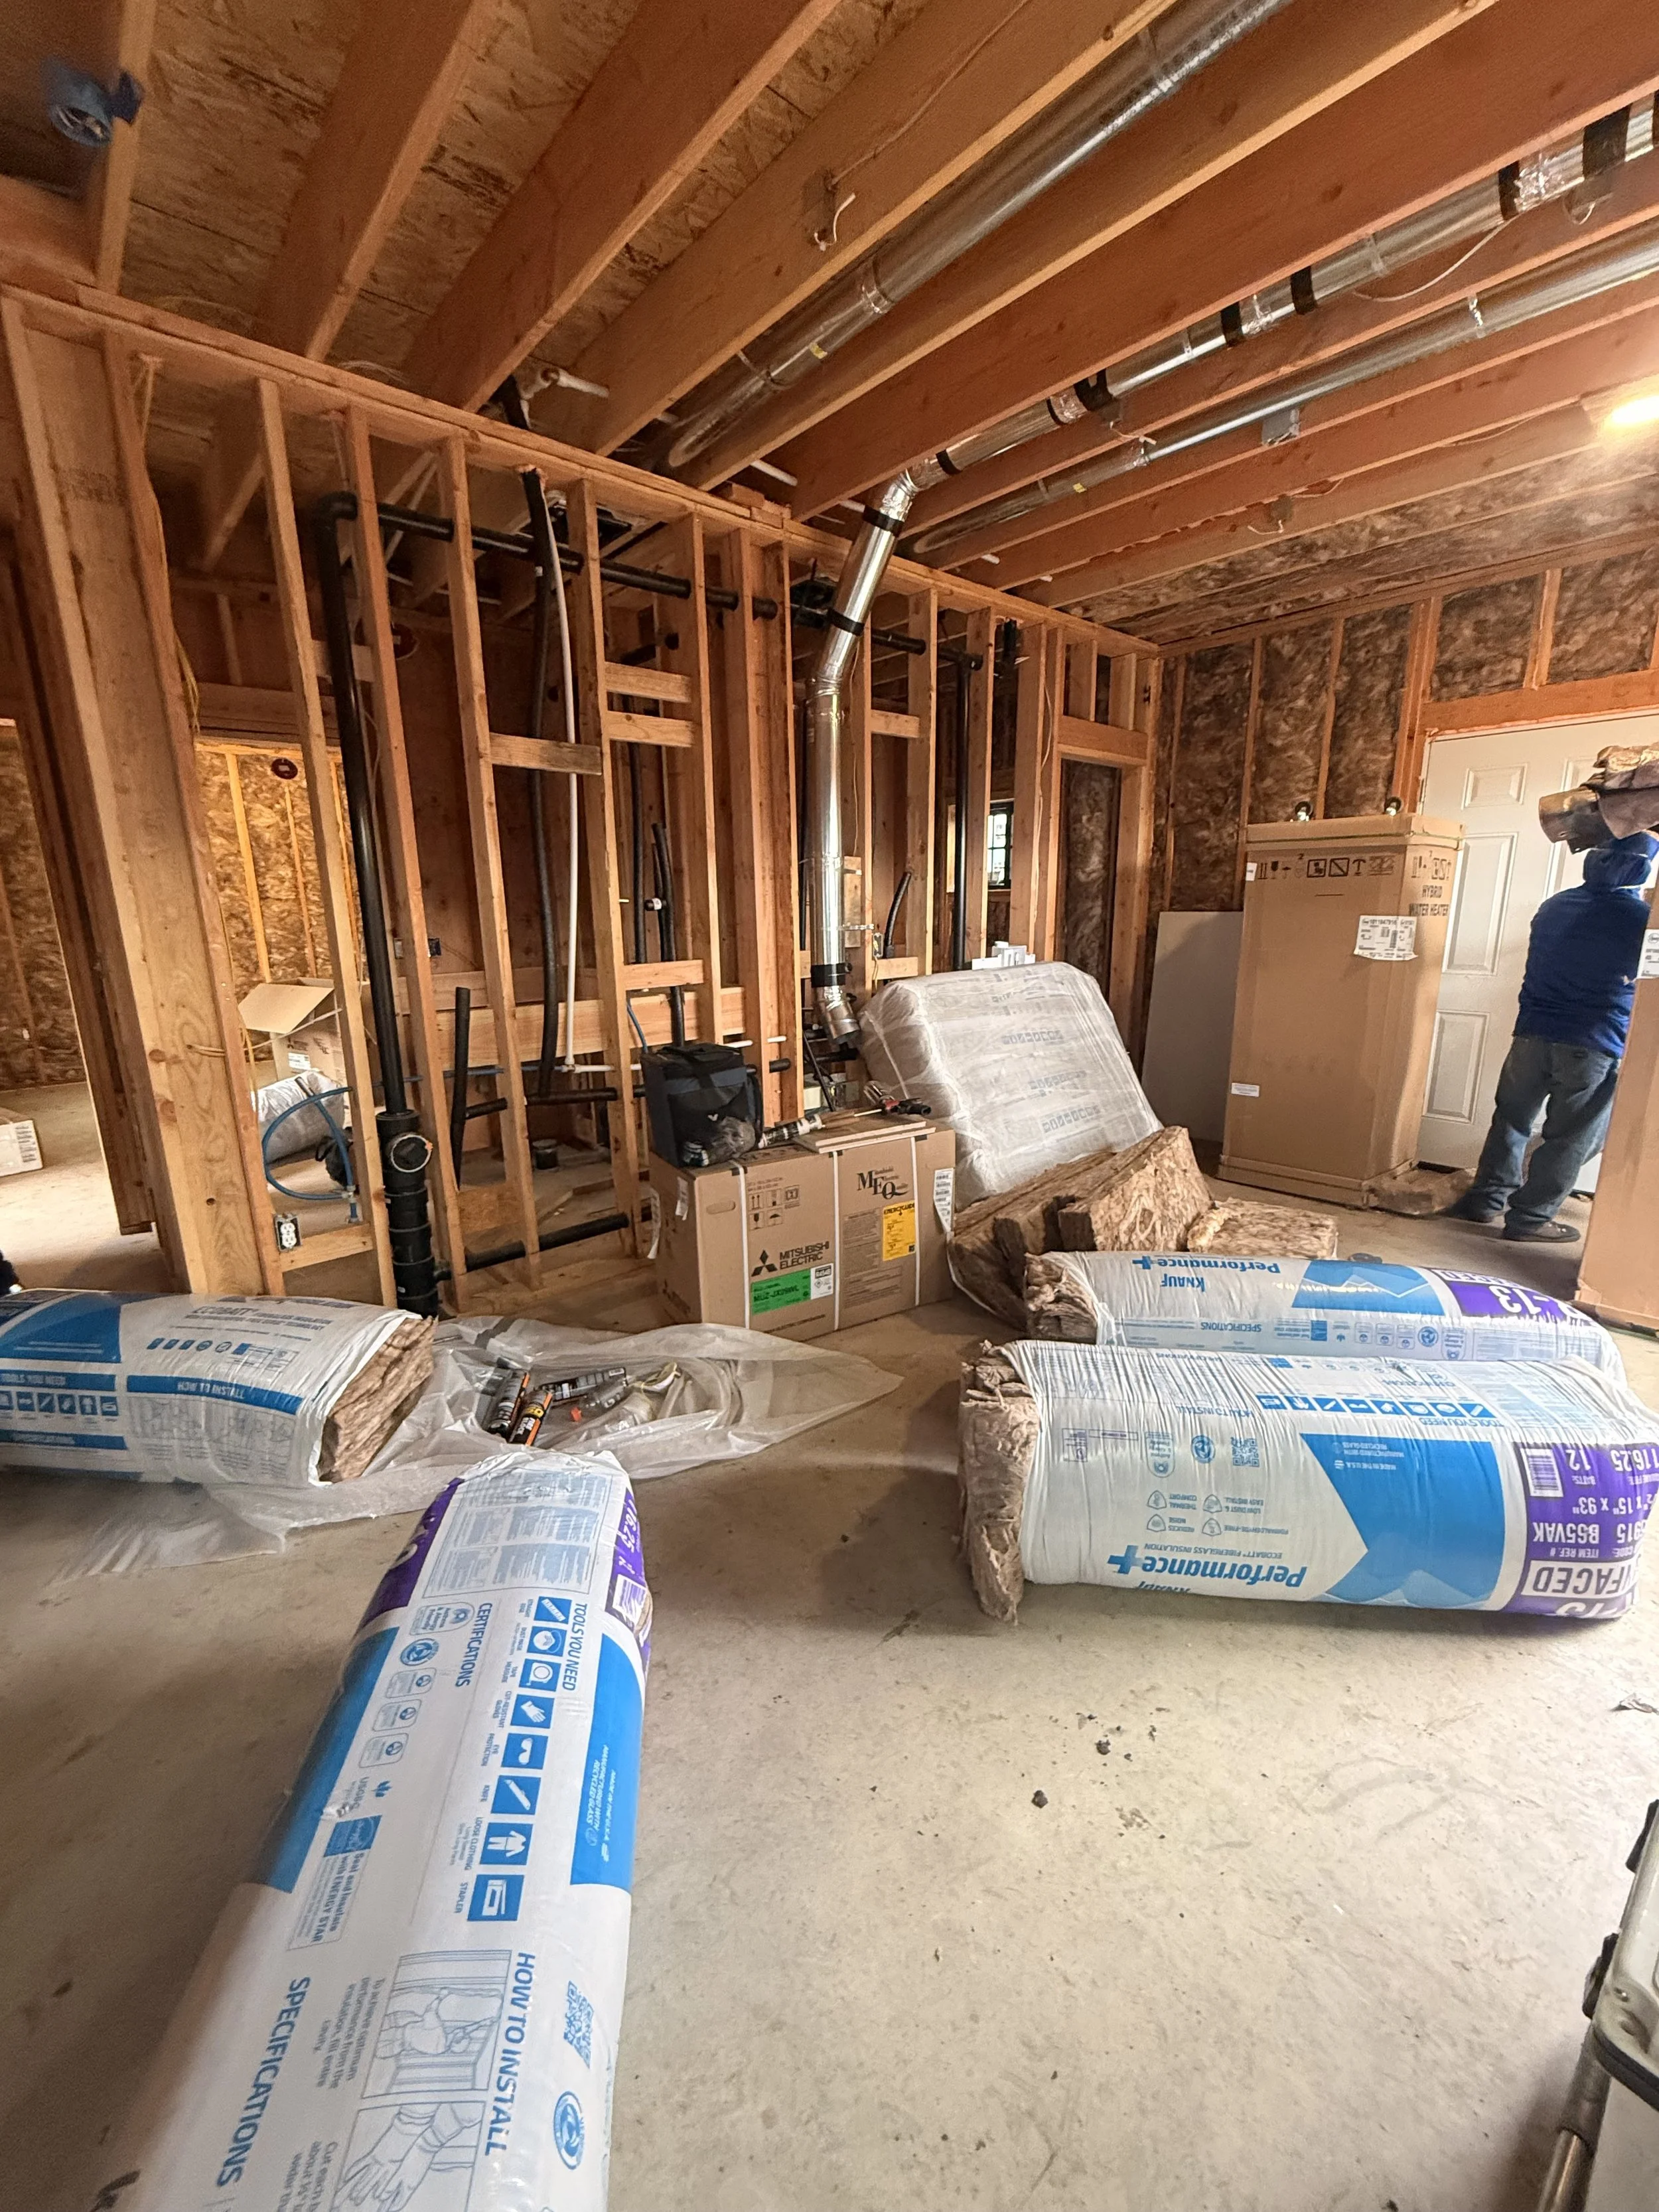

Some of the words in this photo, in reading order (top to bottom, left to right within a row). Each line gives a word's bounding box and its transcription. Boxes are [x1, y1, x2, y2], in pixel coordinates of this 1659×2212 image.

[780, 1240, 830, 1260] MITSUBISHI
[780, 1252, 824, 1270] ELECTRIC
[1160, 1274, 1205, 1291] KNAUF
[1200, 1321, 1262, 1333] SPECIFICATIONS
[212, 1384, 246, 1400] INSTALL
[1566, 1448, 1591, 1470] 12
[1611, 1448, 1659, 1472] 116.25
[1572, 1497, 1598, 1515] 93"
[1599, 1497, 1609, 1512] x
[1145, 1543, 1192, 1554] INSULATION
[1194, 1546, 1242, 1557] FIBERGLASS
[1577, 1548, 1599, 1558] ITEM
[571, 1603, 587, 1635] TOOLS
[455, 1602, 493, 1688] CERTIFICATIONS
[567, 1635, 584, 1659] YOU
[562, 1659, 579, 1691] NEED
[480, 1732, 495, 1767] PROTECTION
[589, 1759, 600, 1799] RECYCLED
[480, 1785, 490, 1803] KNIFE
[586, 1799, 596, 1825] GLASS
[471, 1816, 483, 1838] LOOSE
[464, 1838, 480, 1871] CLOTHING
[454, 1881, 469, 1914] STAPLER
[510, 1953, 536, 2010] HOW
[504, 2012, 528, 2044] TO
[216, 1976, 311, 2187] SPECIFICATIONS
[485, 2048, 522, 2156] INSTALL
